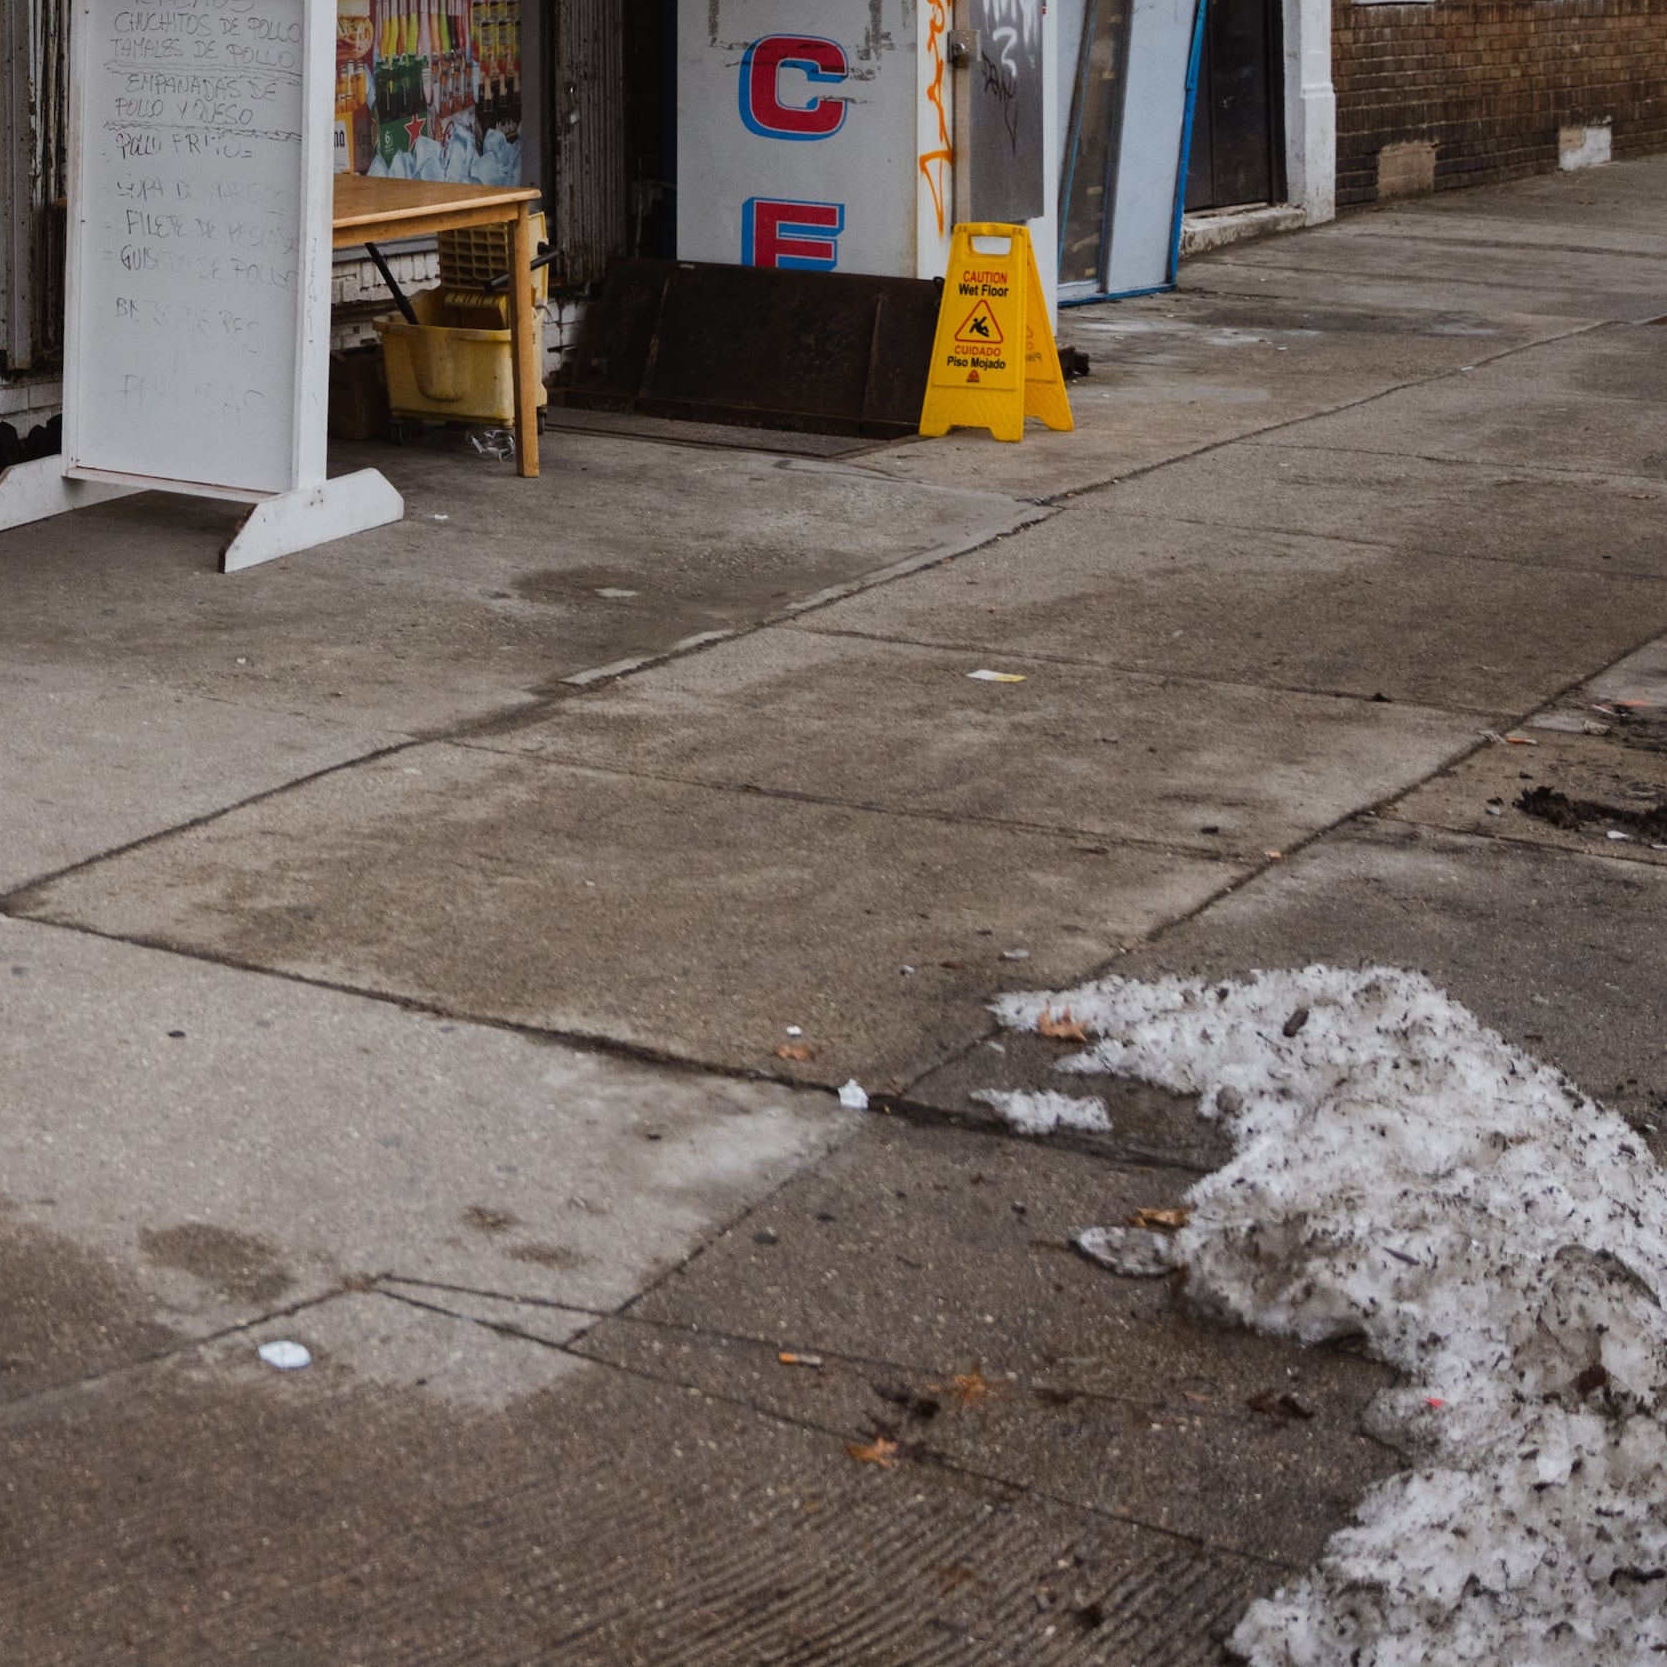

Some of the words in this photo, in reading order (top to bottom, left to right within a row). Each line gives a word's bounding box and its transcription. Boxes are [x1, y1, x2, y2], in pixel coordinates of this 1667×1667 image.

[220, 16, 241, 36] DE
[248, 17, 301, 45] POLLO
[110, 36, 183, 58] TAMALES
[194, 39, 219, 60] DE
[227, 43, 296, 71] POLLO
[126, 73, 242, 102] EMPANADAS
[250, 78, 277, 102] DE
[963, 270, 1008, 284] CAUTION
[959, 283, 979, 296] Wet
[981, 284, 1009, 297] Floor
[954, 345, 1001, 357] CUIDADO
[947, 355, 968, 368] Piso
[971, 357, 1006, 371] Mojado
